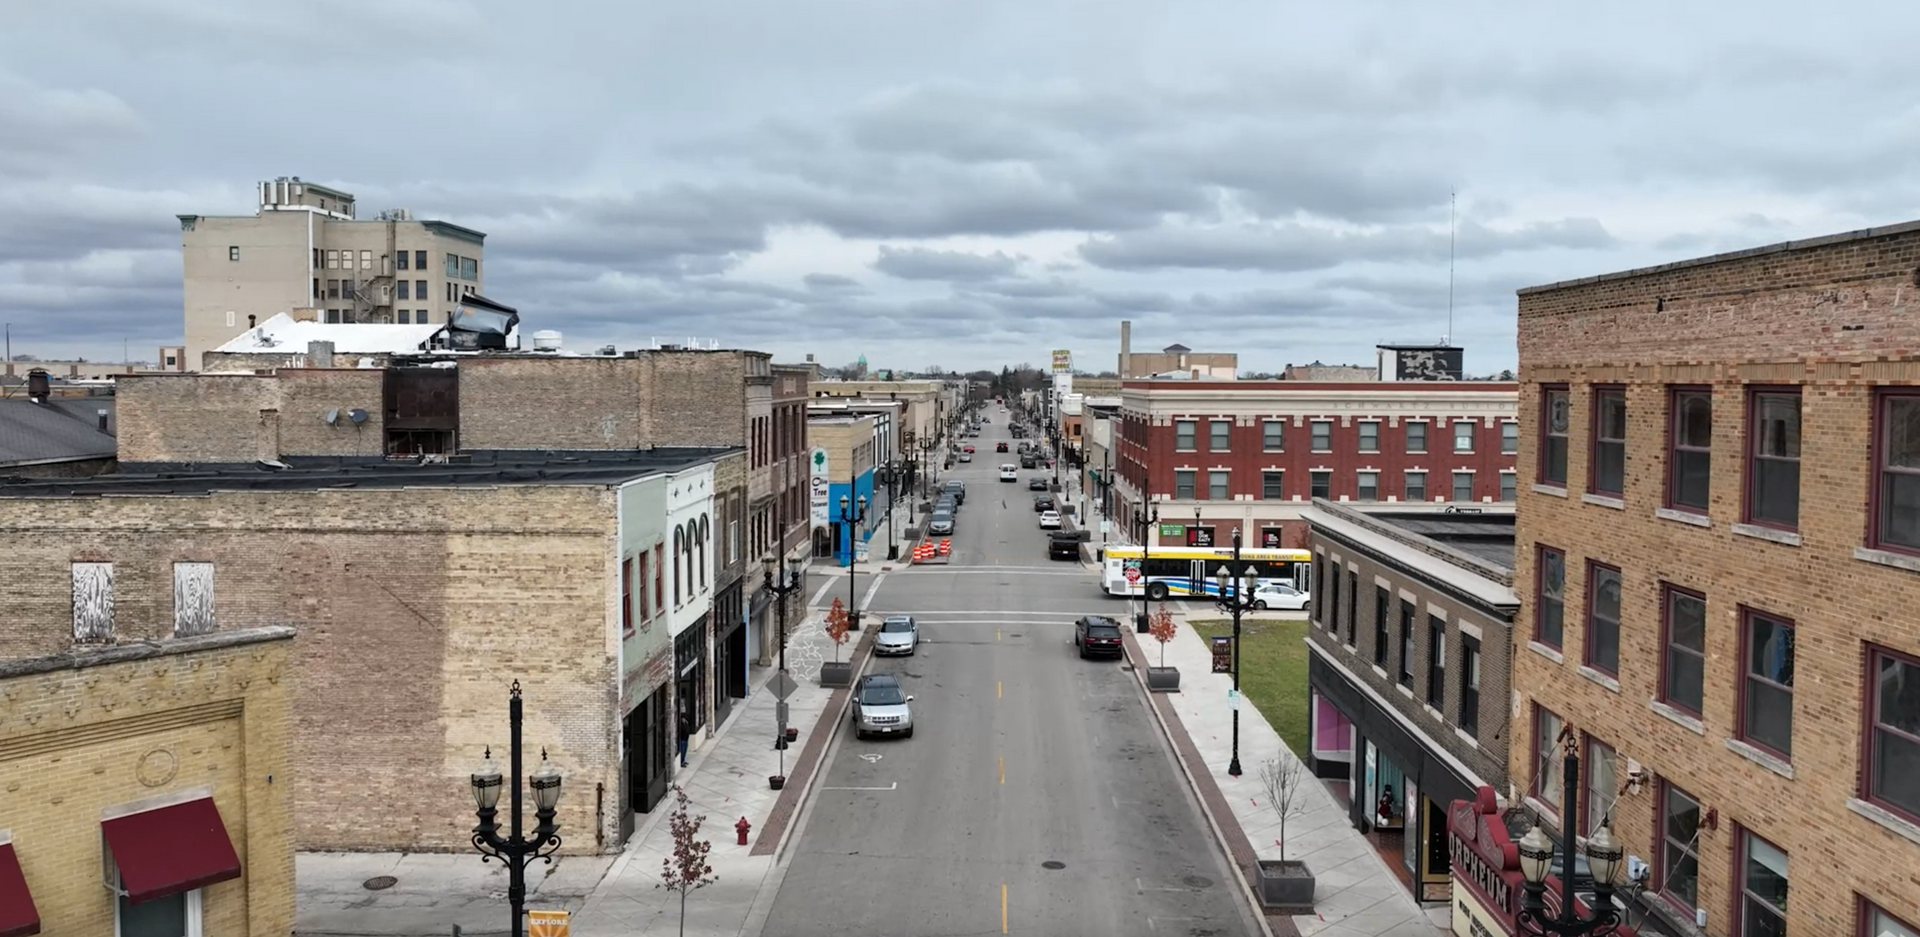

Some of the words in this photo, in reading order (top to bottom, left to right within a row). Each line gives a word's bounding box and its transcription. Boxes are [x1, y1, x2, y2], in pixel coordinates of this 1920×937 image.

[812, 477, 828, 487] Olive
[813, 488, 827, 496] Tree
[1448, 831, 1508, 914] ORPHEUM
